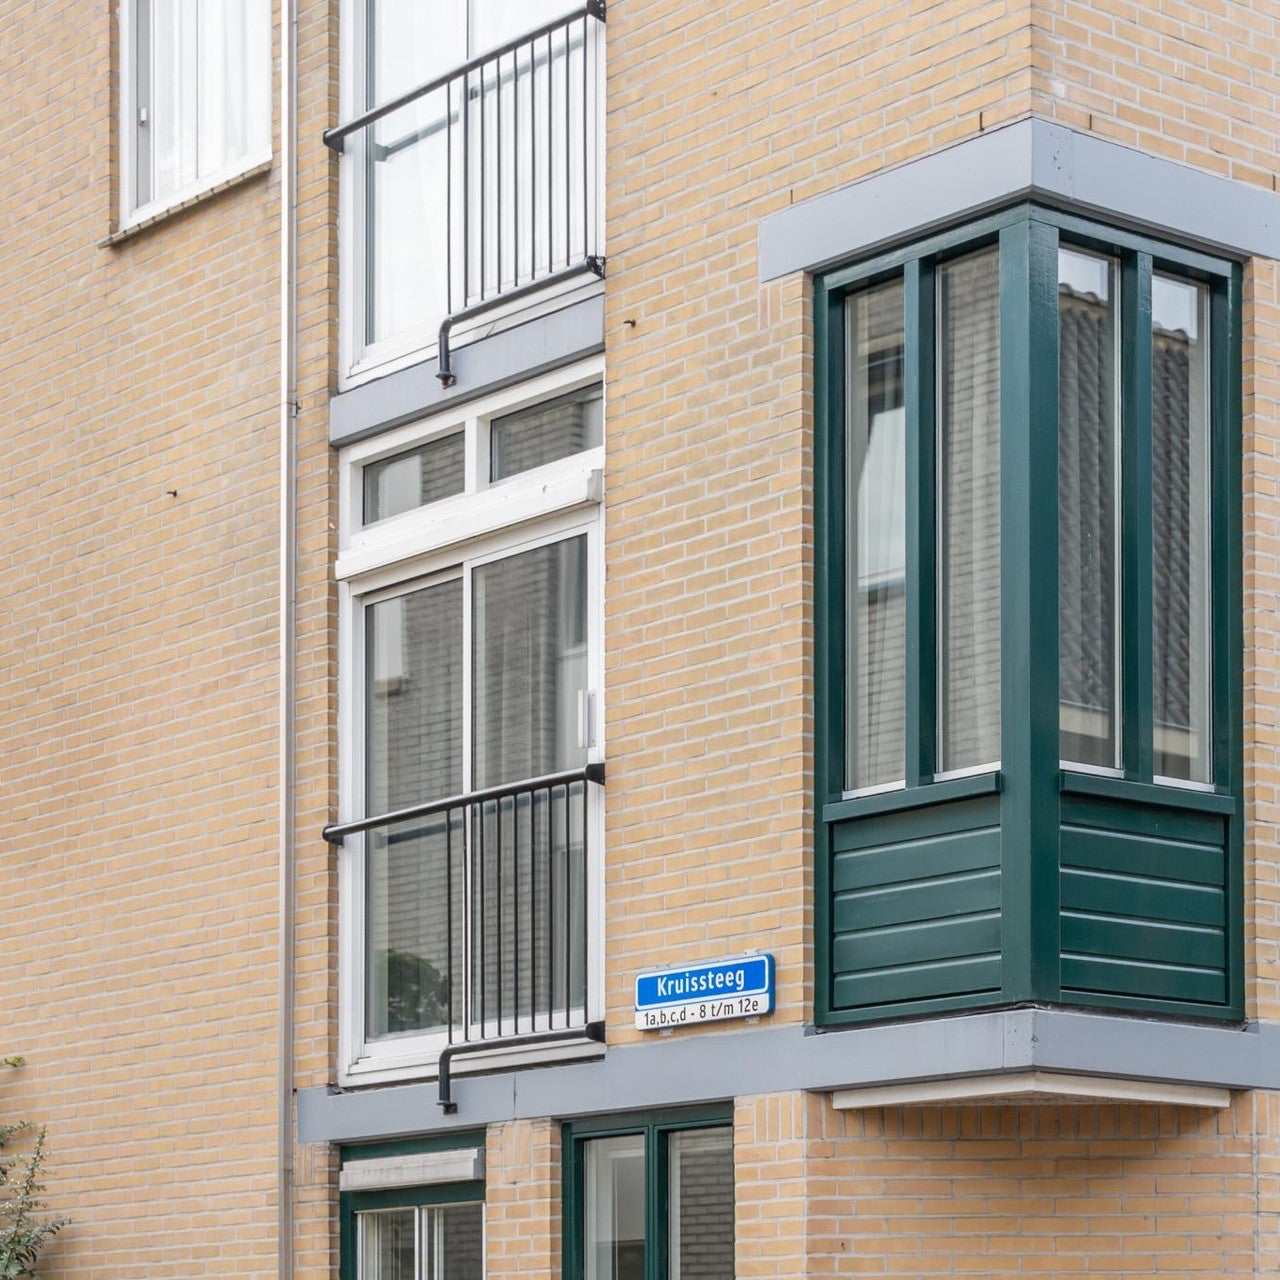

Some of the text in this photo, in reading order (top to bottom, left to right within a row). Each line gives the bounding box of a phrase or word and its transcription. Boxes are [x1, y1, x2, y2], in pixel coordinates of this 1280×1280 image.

[657, 970, 745, 996] Kruissteeg
[644, 1007, 686, 1026] 1a,b,c,d
[699, 1004, 707, 1019] 8
[711, 1002, 734, 1018] t/m
[738, 998, 759, 1014] 12e
